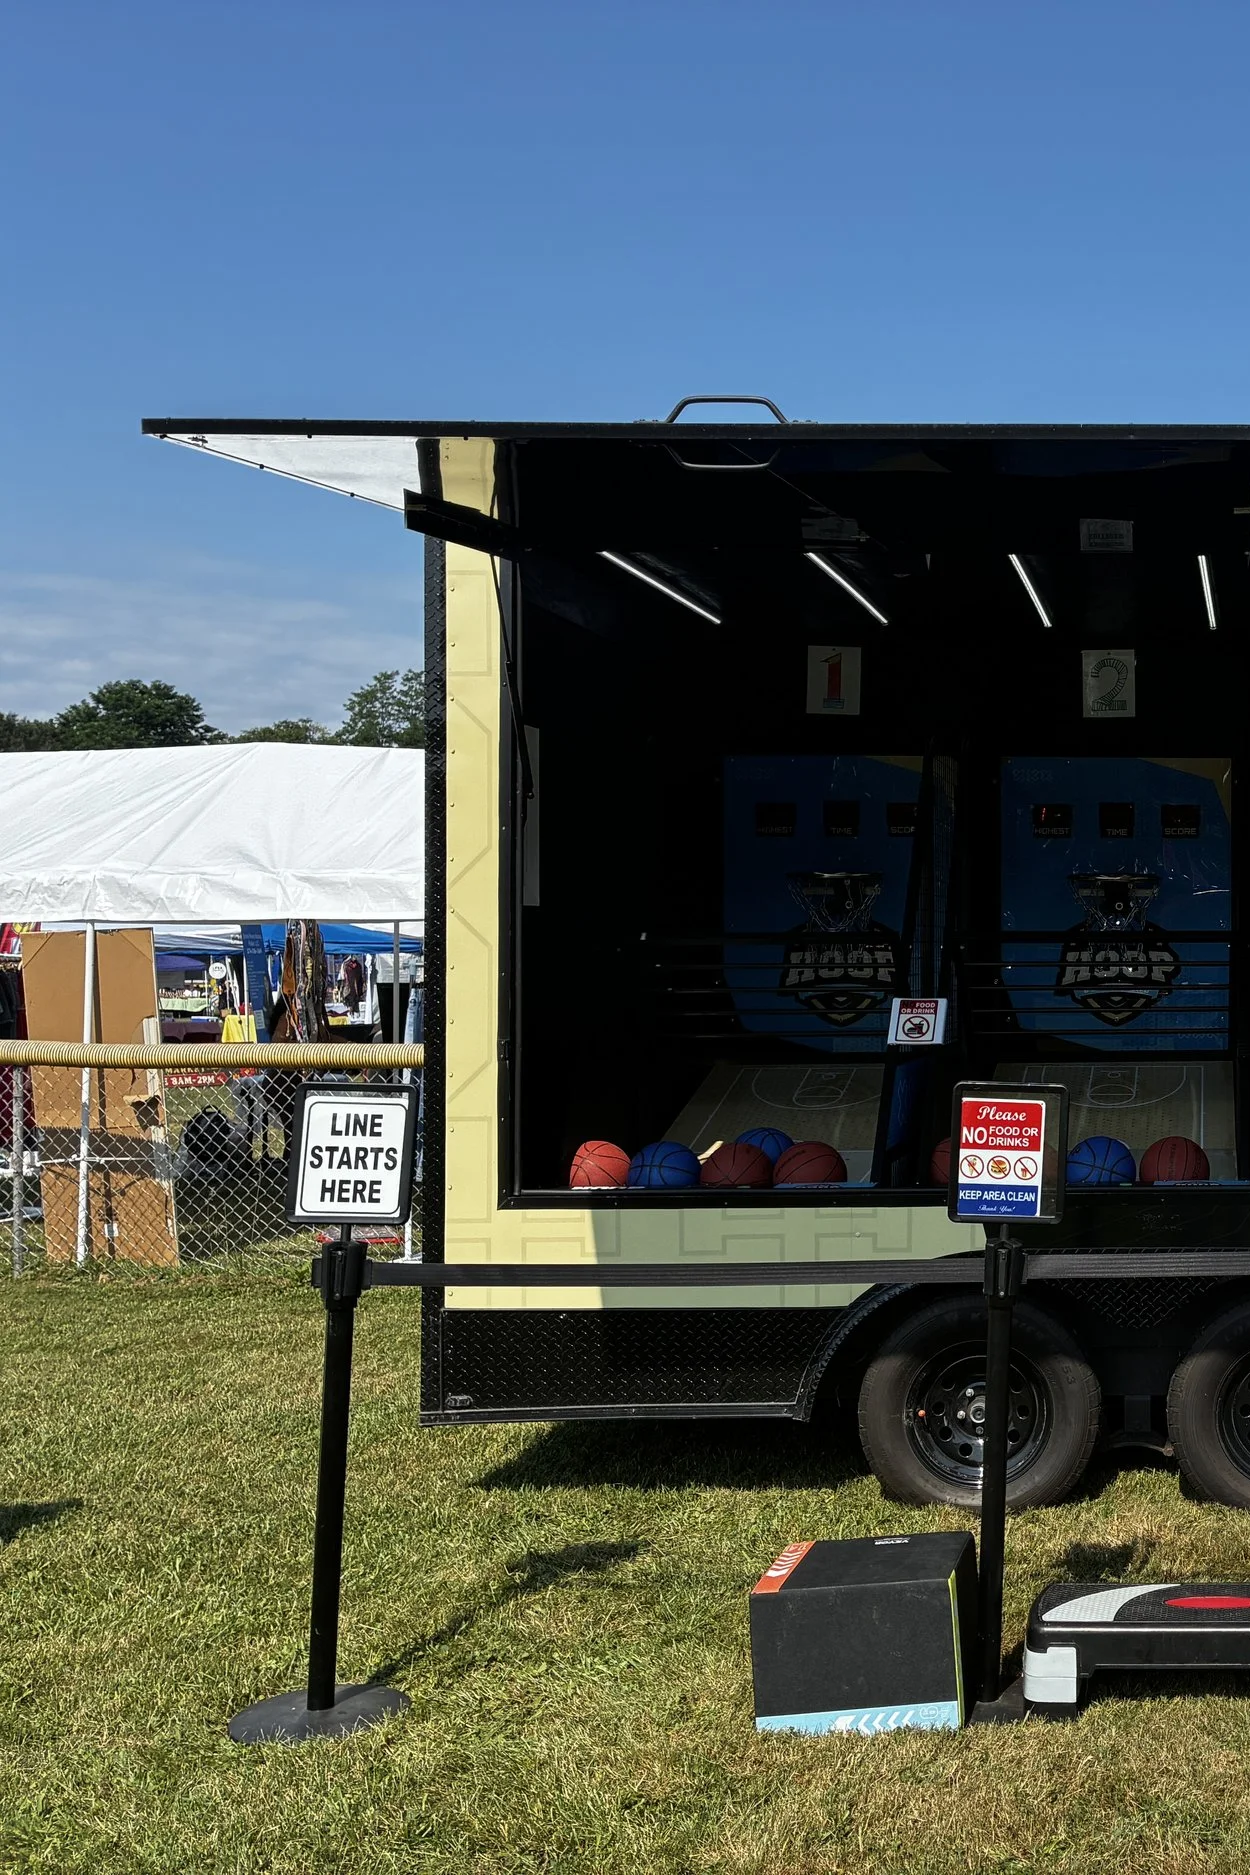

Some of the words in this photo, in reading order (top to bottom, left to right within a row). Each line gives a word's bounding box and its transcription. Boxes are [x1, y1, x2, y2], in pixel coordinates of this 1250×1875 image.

[820, 652, 845, 709] 1
[1091, 658, 1128, 711] 2
[831, 827, 852, 835] TIME
[1106, 828, 1128, 837] TIME
[1163, 827, 1197, 836] SCORE
[1061, 950, 1177, 986] HOOP
[976, 1105, 1027, 1121] Please
[331, 1113, 383, 1137] LINE
[962, 1126, 987, 1144] NO
[989, 1125, 1020, 1136] FOOD
[1022, 1127, 1039, 1137] OR
[988, 1137, 1030, 1147] DRINKS
[309, 1146, 398, 1171] STARTS
[320, 1179, 381, 1204] HERE
[959, 1190, 981, 1200] KEEP
[983, 1191, 1006, 1201] AREA
[1007, 1191, 1036, 1202] CLEAN
[978, 1204, 997, 1212] Thank
